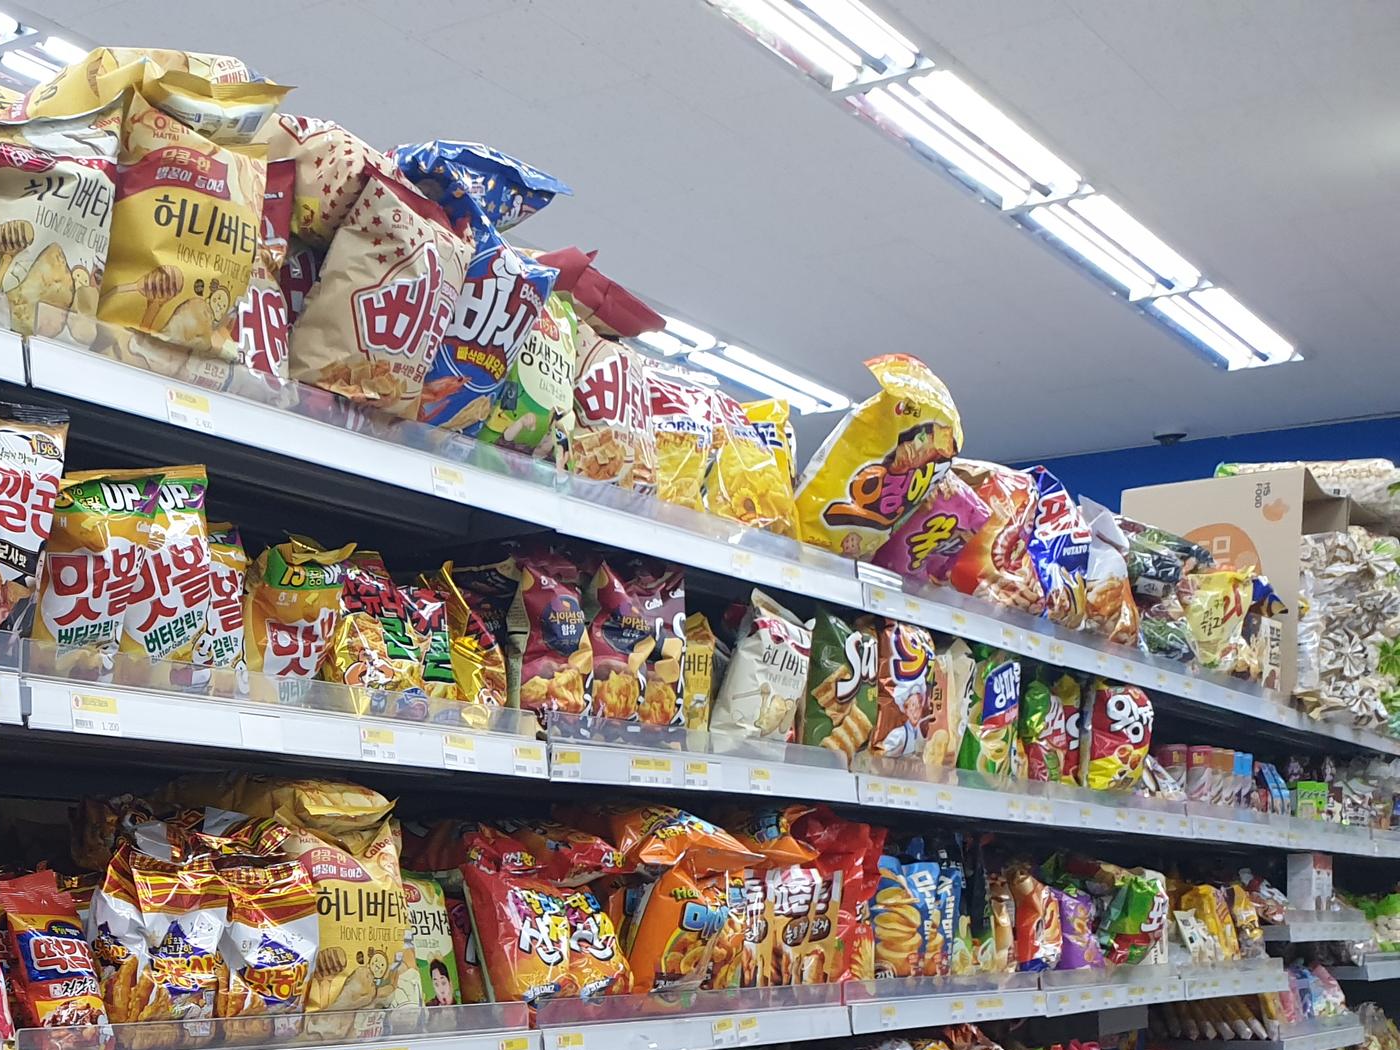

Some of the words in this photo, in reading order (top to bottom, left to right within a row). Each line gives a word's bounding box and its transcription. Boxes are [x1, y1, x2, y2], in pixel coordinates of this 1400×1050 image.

[152, 131, 180, 142] HAITAI
[154, 194, 260, 264] 허니버터
[176, 243, 211, 269] HONEY
[102, 482, 141, 512] UP
[1254, 482, 1263, 509] FOOD
[144, 612, 198, 654] 버터갈릭
